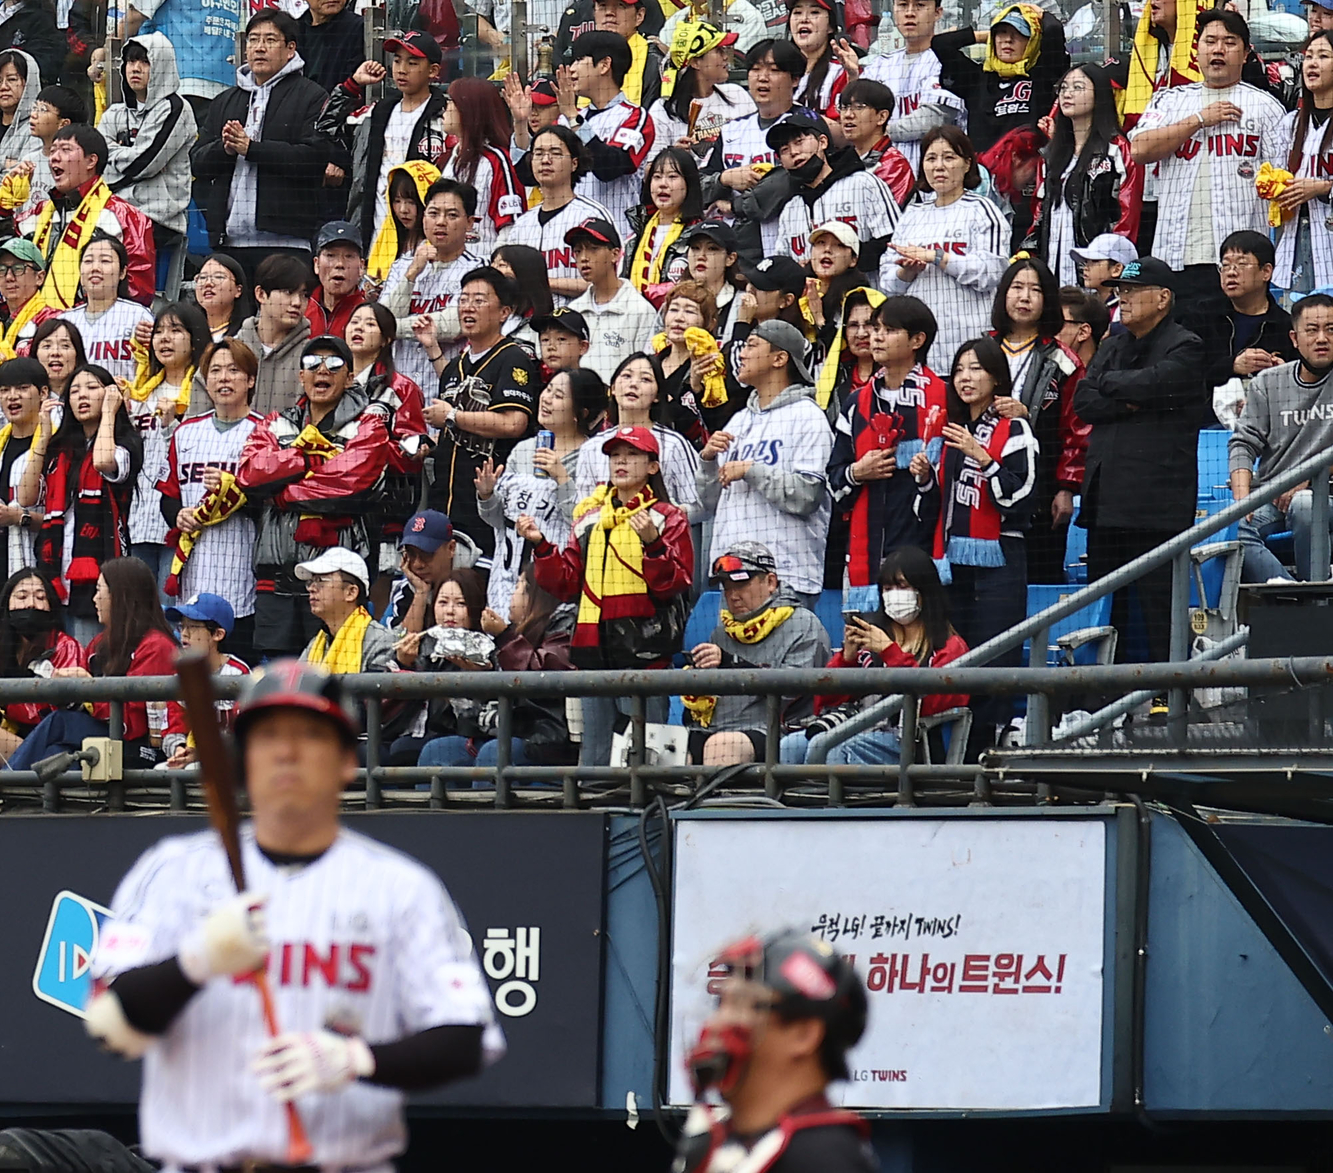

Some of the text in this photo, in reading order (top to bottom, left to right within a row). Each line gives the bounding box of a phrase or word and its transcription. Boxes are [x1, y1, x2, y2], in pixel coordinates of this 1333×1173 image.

[1000, 81, 1034, 101] LG
[1239, 118, 1256, 132] LG
[811, 913, 961, 942] 무적 LG! 끝까지 TWINS!
[866, 954, 1066, 994] 하나의 트윈스!
[854, 1069, 907, 1083] LG TWINS
